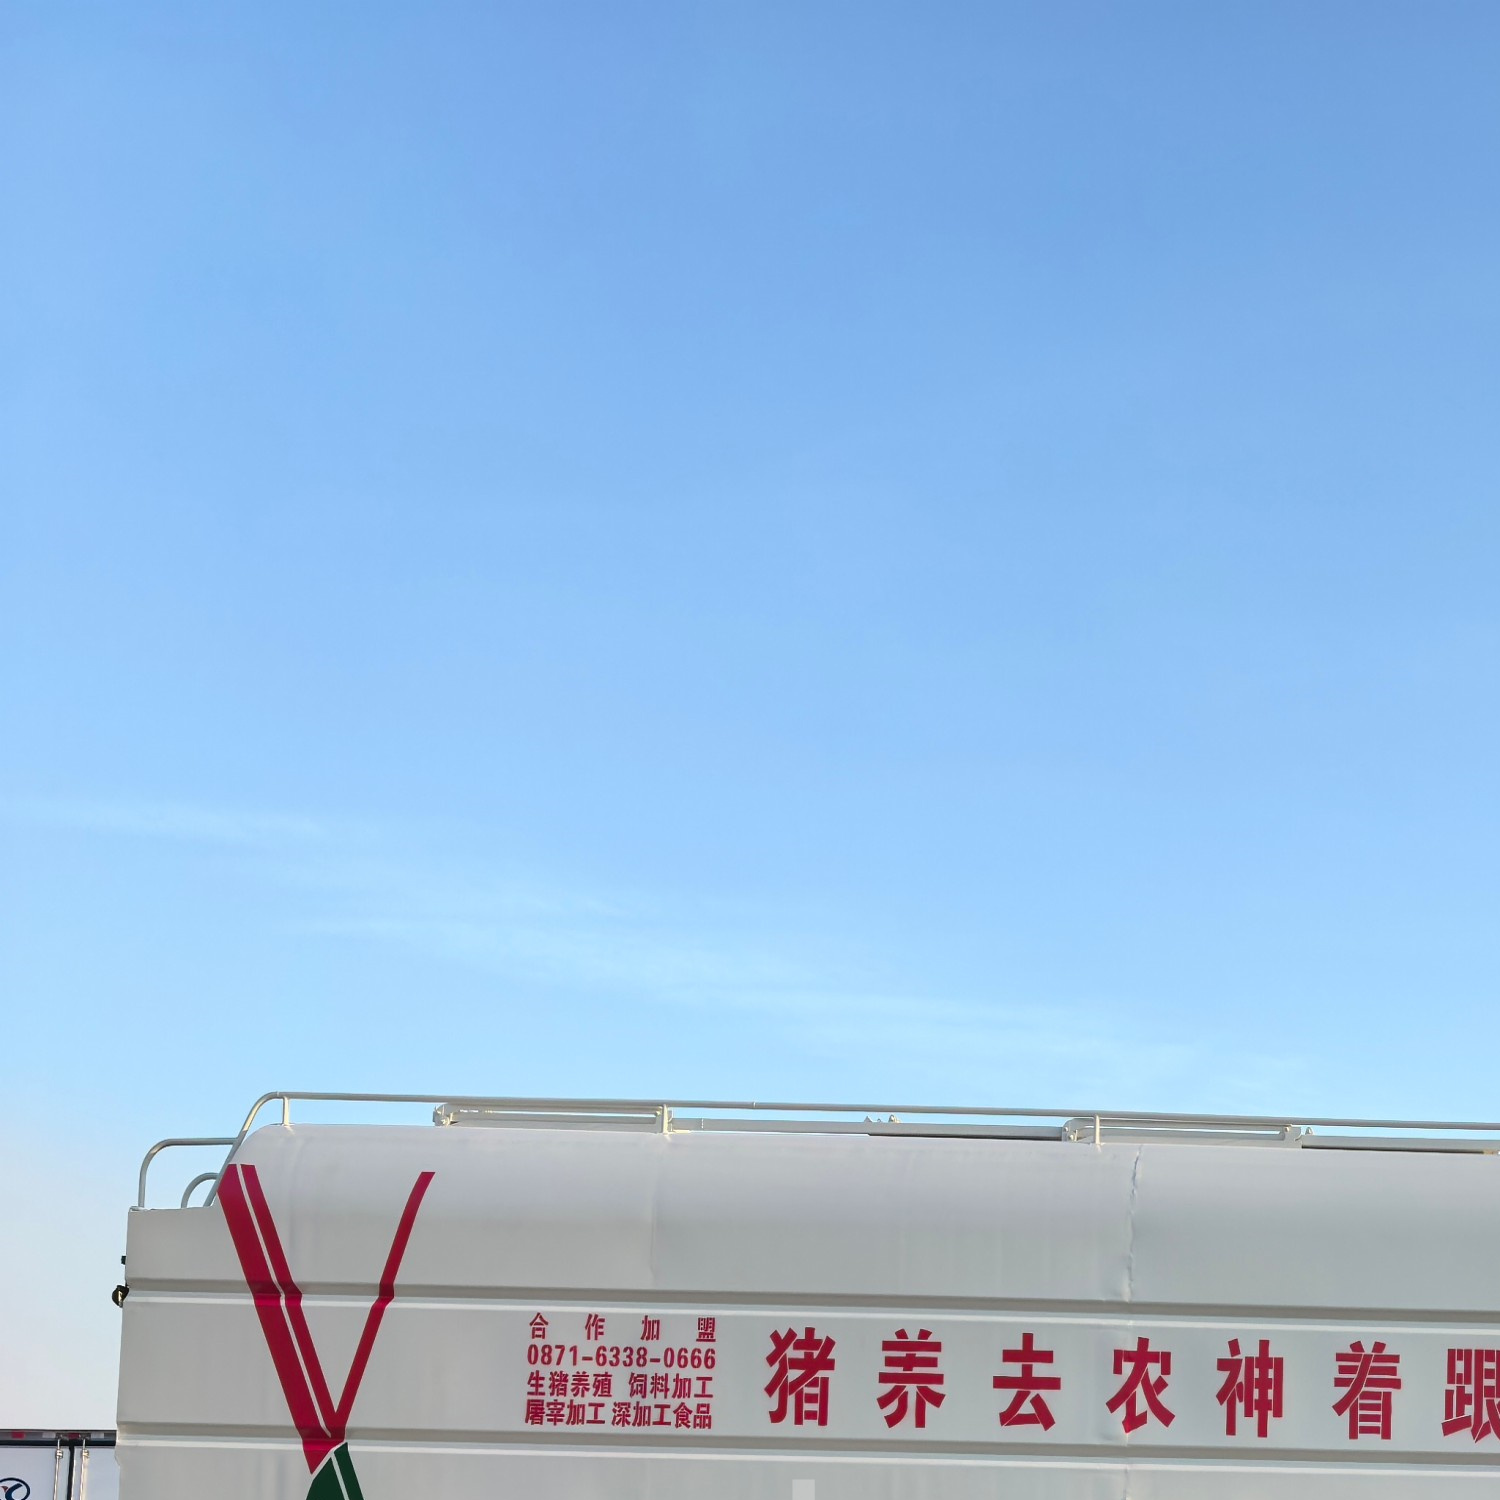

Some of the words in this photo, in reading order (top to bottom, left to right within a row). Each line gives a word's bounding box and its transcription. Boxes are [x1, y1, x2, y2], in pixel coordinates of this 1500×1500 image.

[529, 1312, 716, 1342] 合作加盟
[527, 1343, 716, 1369] 0871-6338-0666
[526, 1369, 613, 1398] 生猪养殖
[628, 1371, 714, 1399] 饲料加工
[524, 1399, 605, 1426] 屠宰加工
[611, 1400, 713, 1430] 深加工食品
